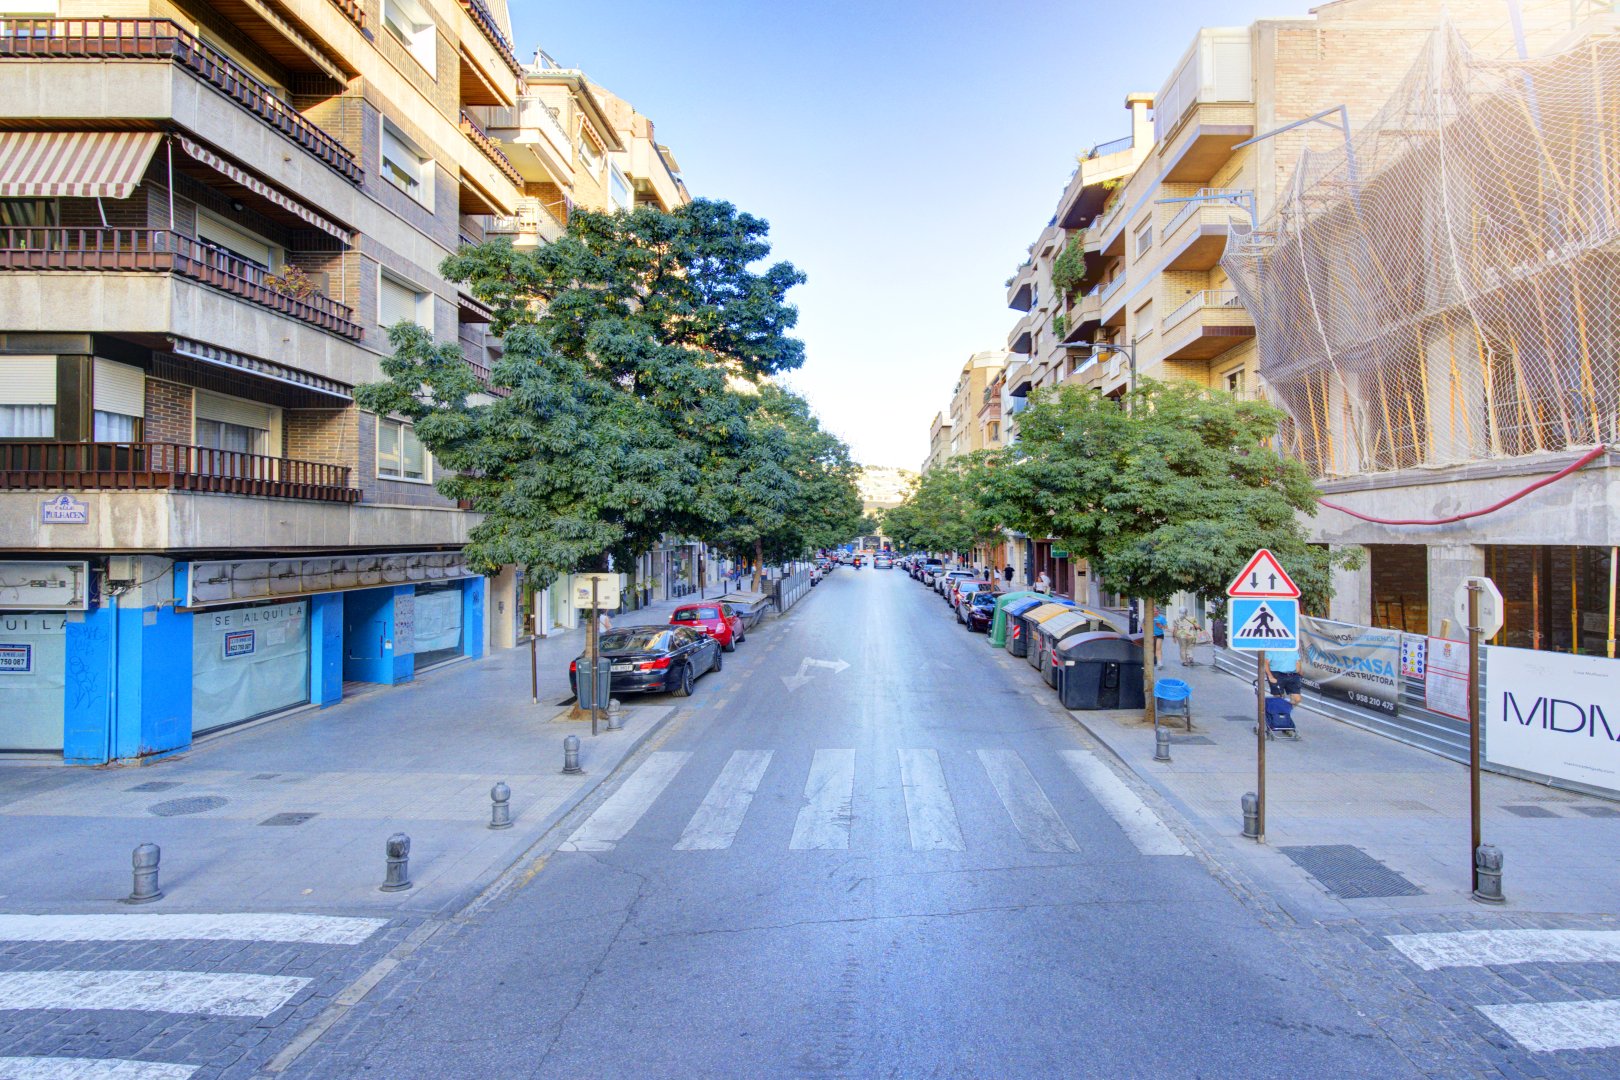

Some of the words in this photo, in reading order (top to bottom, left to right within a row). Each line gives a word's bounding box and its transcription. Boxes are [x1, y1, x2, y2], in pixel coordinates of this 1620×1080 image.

[215, 616, 230, 626] SE
[244, 606, 302, 623] ALQUILA
[1313, 661, 1341, 674] EMPRESA
[1356, 694, 1368, 703] 958
[1369, 697, 1380, 706] 210
[1382, 701, 1394, 711] 475
